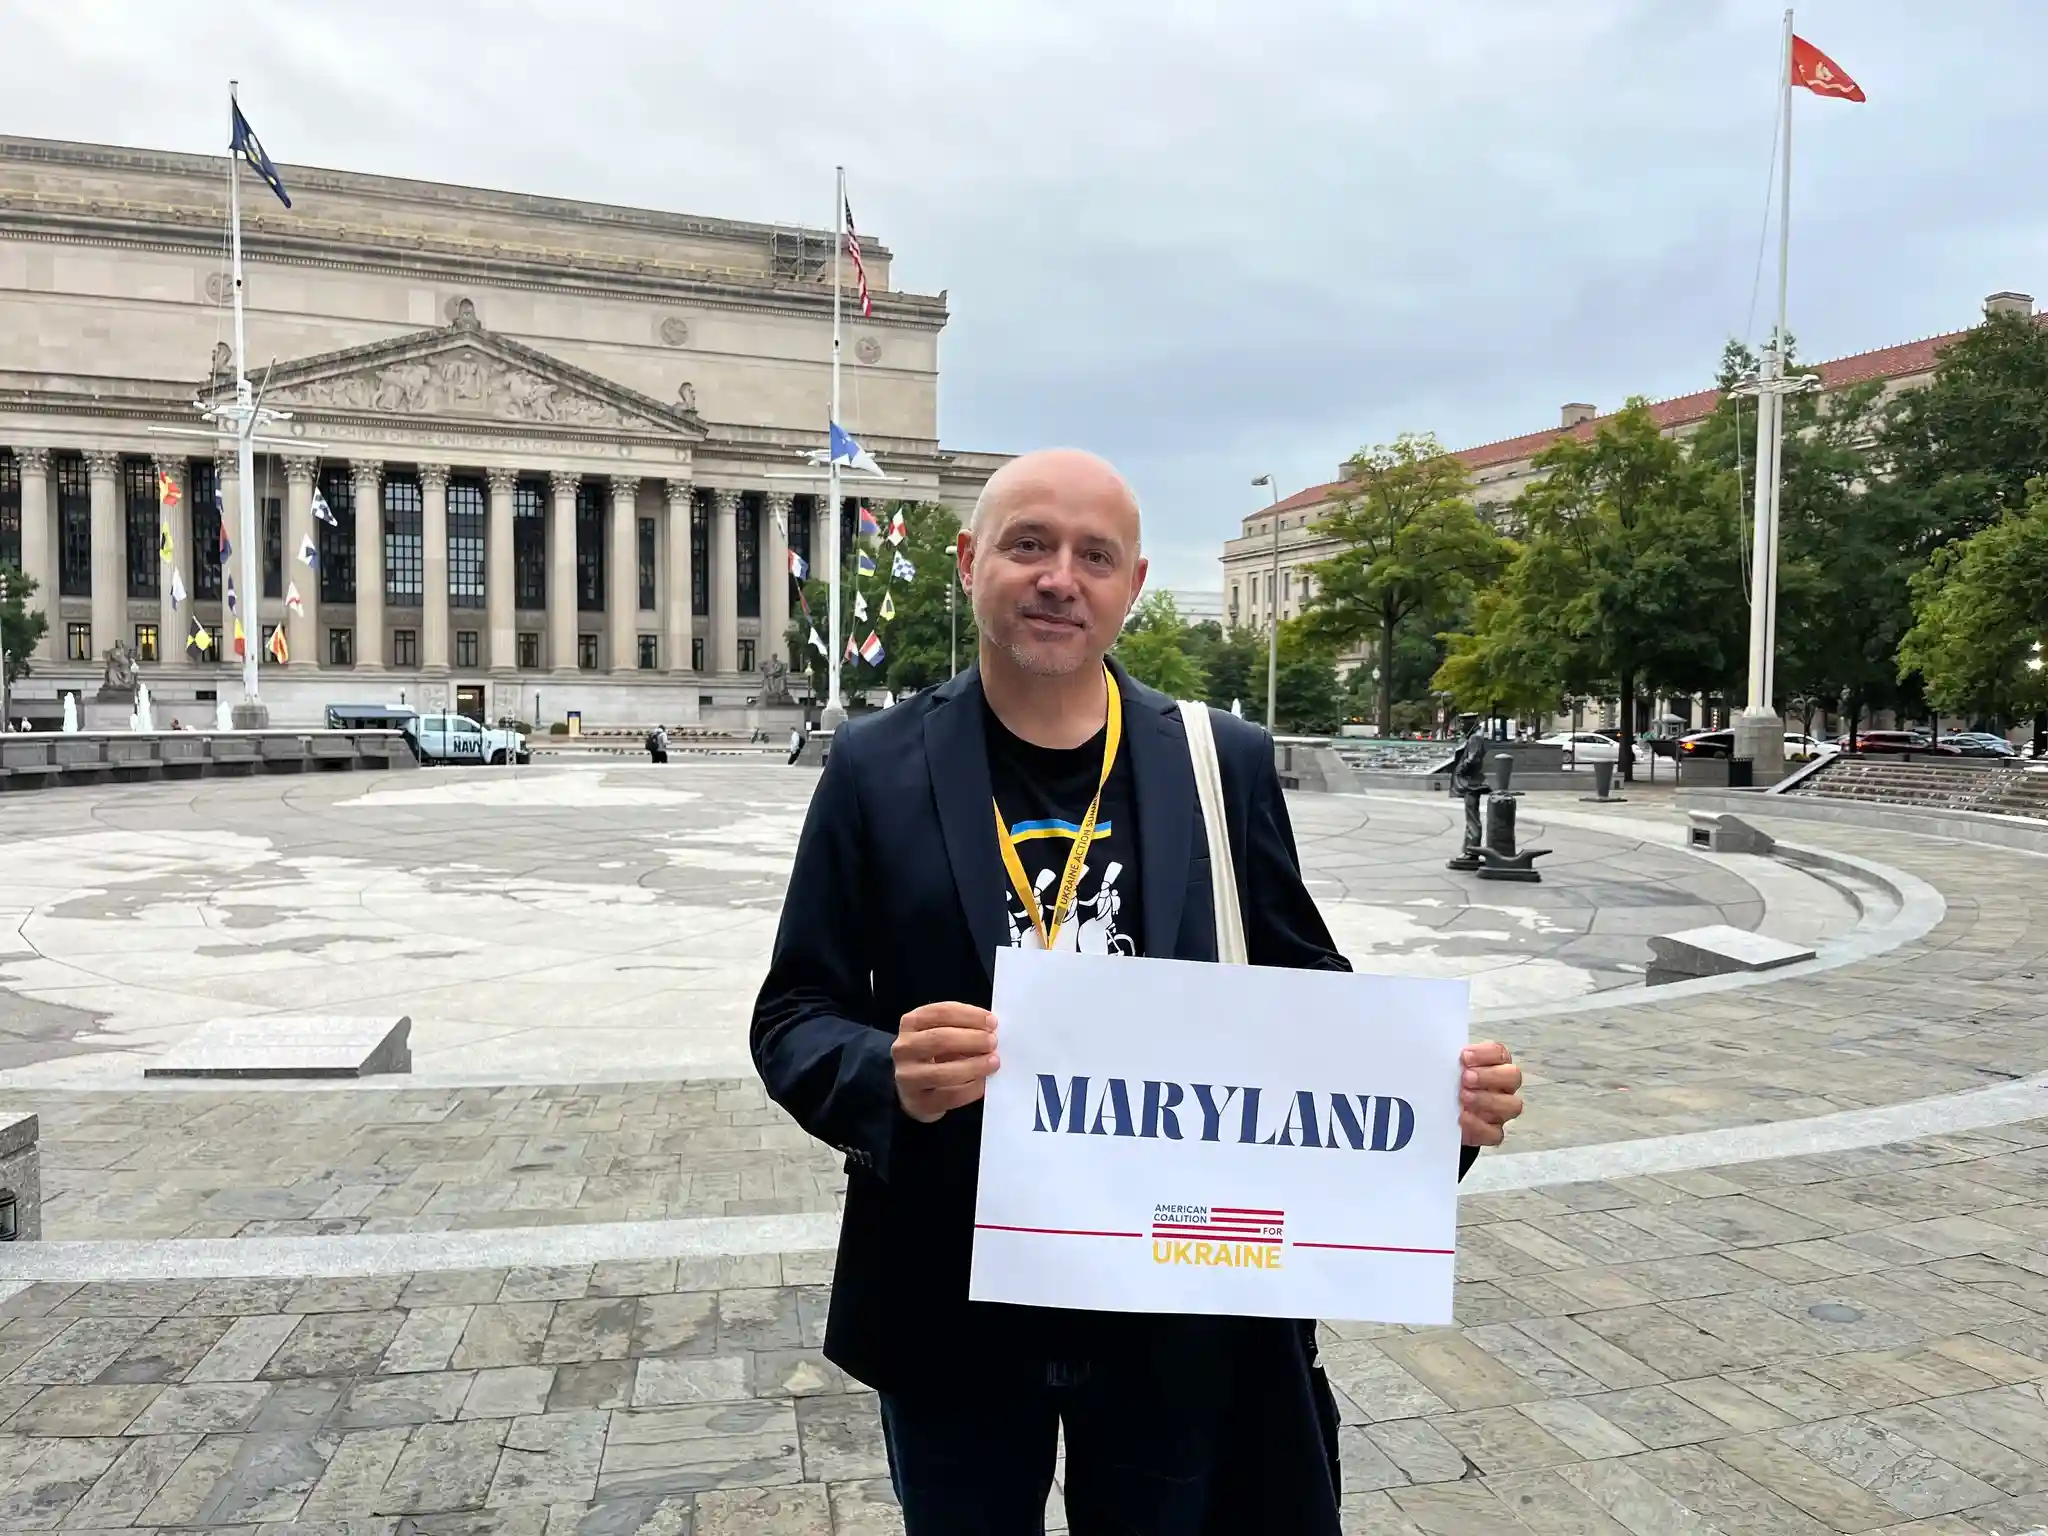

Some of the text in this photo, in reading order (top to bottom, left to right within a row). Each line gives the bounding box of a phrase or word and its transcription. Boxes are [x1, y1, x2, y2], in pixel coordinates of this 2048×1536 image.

[453, 740, 482, 753] NAVY
[1060, 863, 1079, 905] UKRAINE
[1074, 829, 1090, 863] ACTION
[1032, 1073, 1415, 1152] MARYLAND
[1154, 1204, 1208, 1214] AMERICAN
[1153, 1213, 1208, 1223] COALITION
[1262, 1227, 1283, 1236] FOR
[1152, 1240, 1282, 1269] UKRAINE
